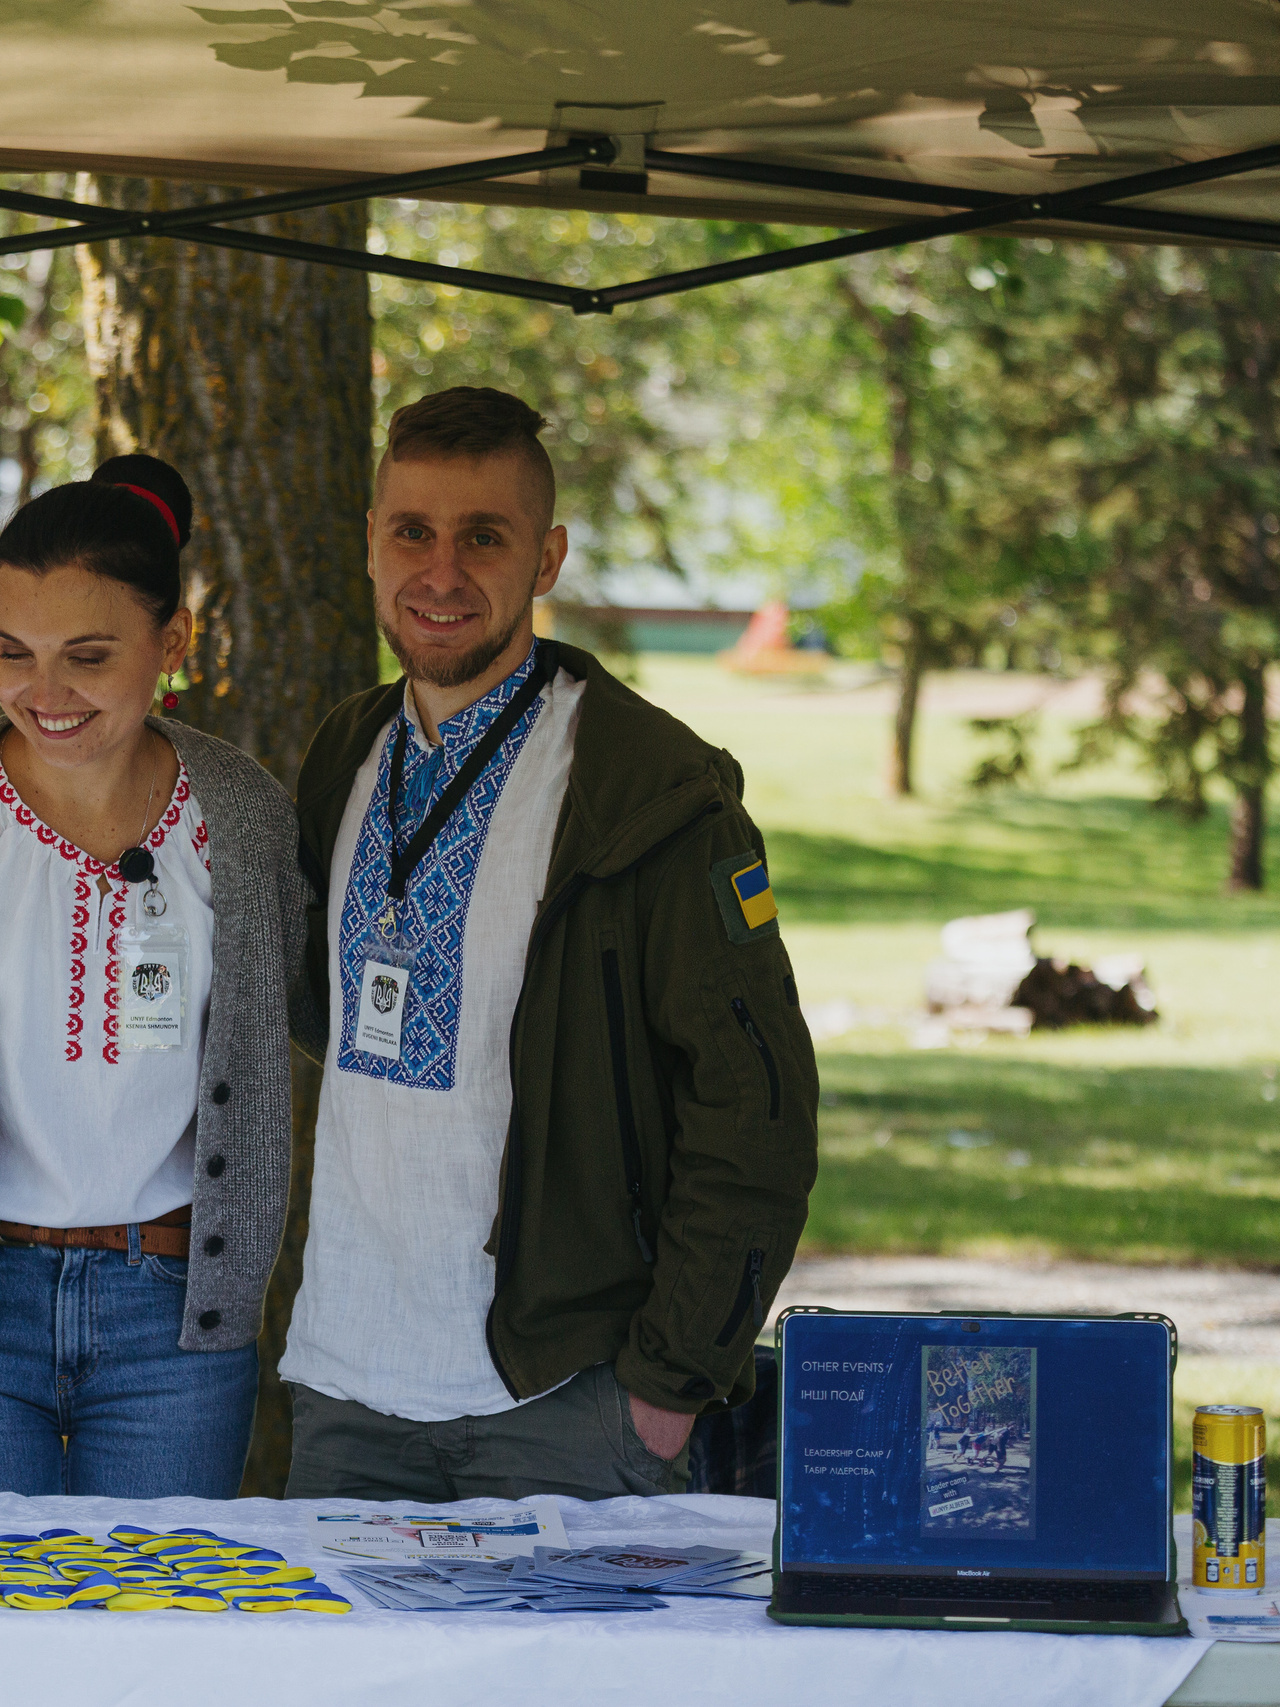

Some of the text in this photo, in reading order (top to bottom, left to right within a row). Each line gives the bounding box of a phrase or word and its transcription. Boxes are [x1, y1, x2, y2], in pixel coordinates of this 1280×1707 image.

[801, 1361, 840, 1372] OTHER
[843, 1362, 884, 1373] EVENTS
[927, 1351, 993, 1397] Better
[926, 1476, 967, 1493] Leader camp
[943, 1489, 957, 1498] with
